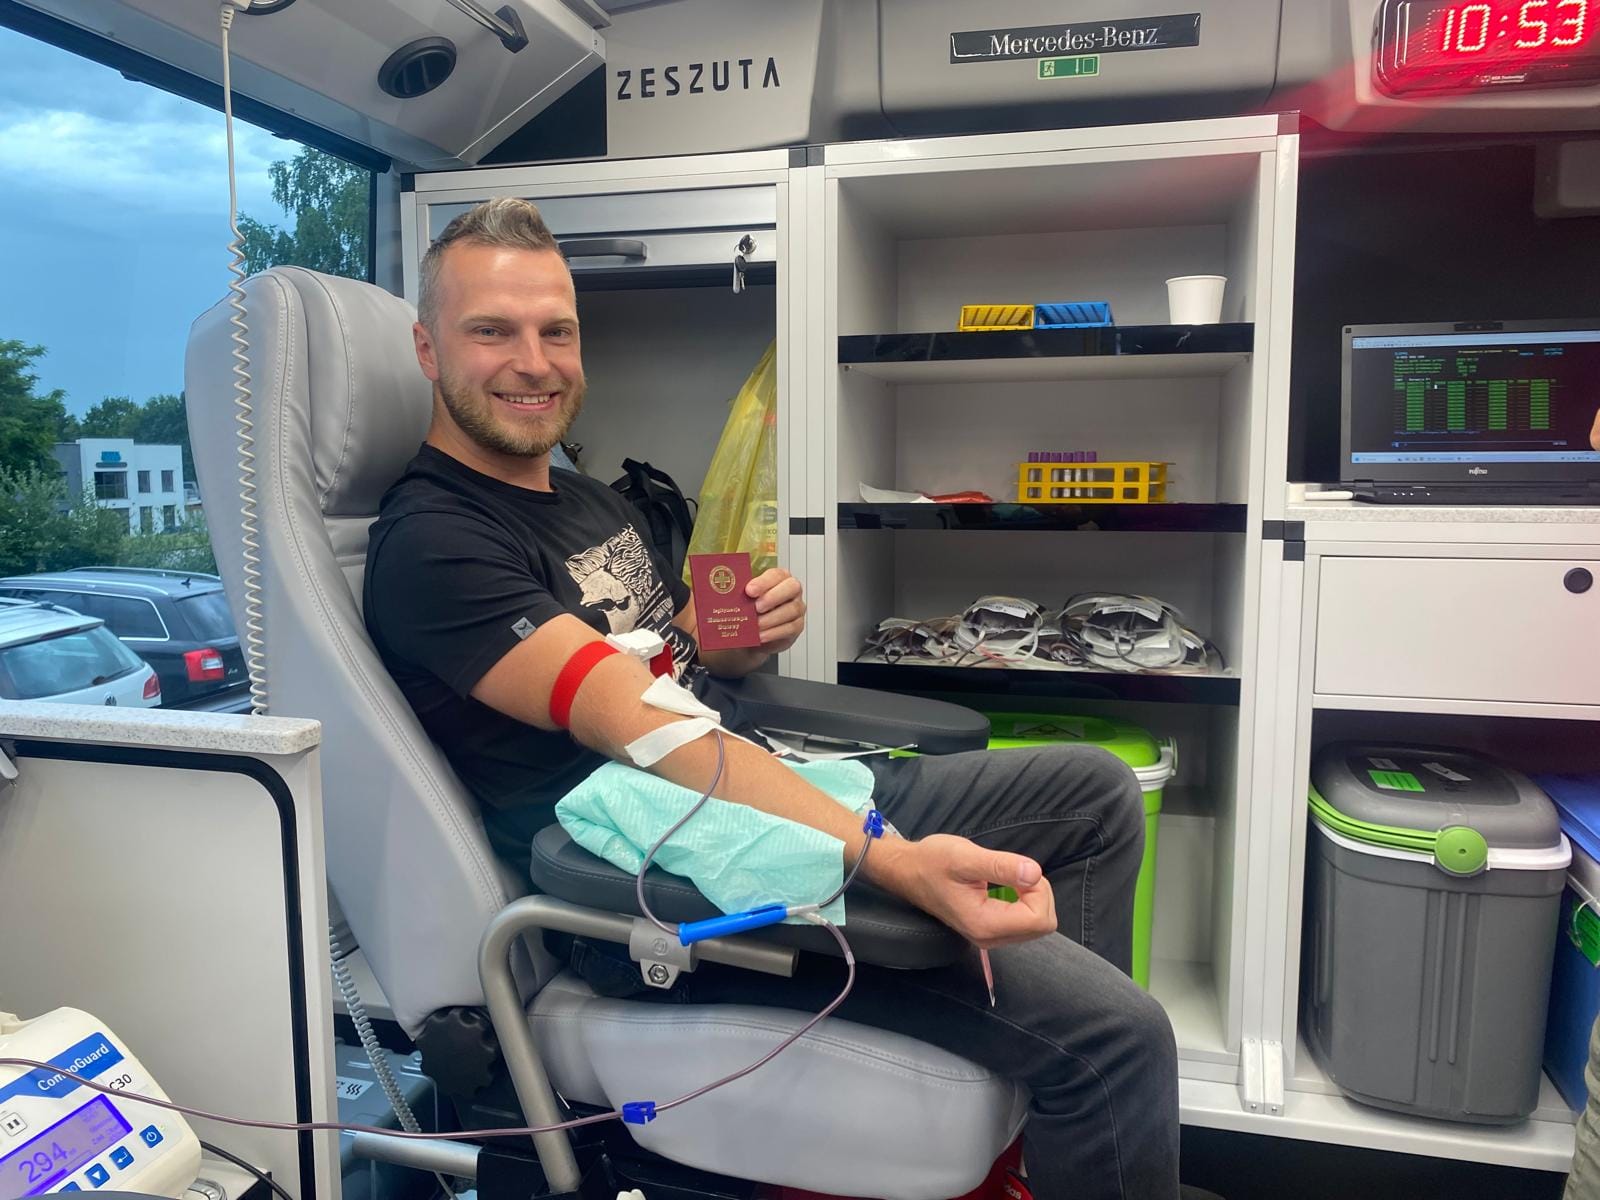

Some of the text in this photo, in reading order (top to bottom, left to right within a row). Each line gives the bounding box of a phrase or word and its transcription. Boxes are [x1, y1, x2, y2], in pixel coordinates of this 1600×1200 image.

[989, 26, 1158, 56] Mercedes-Benz
[1441, 0, 1588, 52] 10:53
[616, 57, 780, 101] ZESZUTA
[18, 1141, 68, 1184] 294
